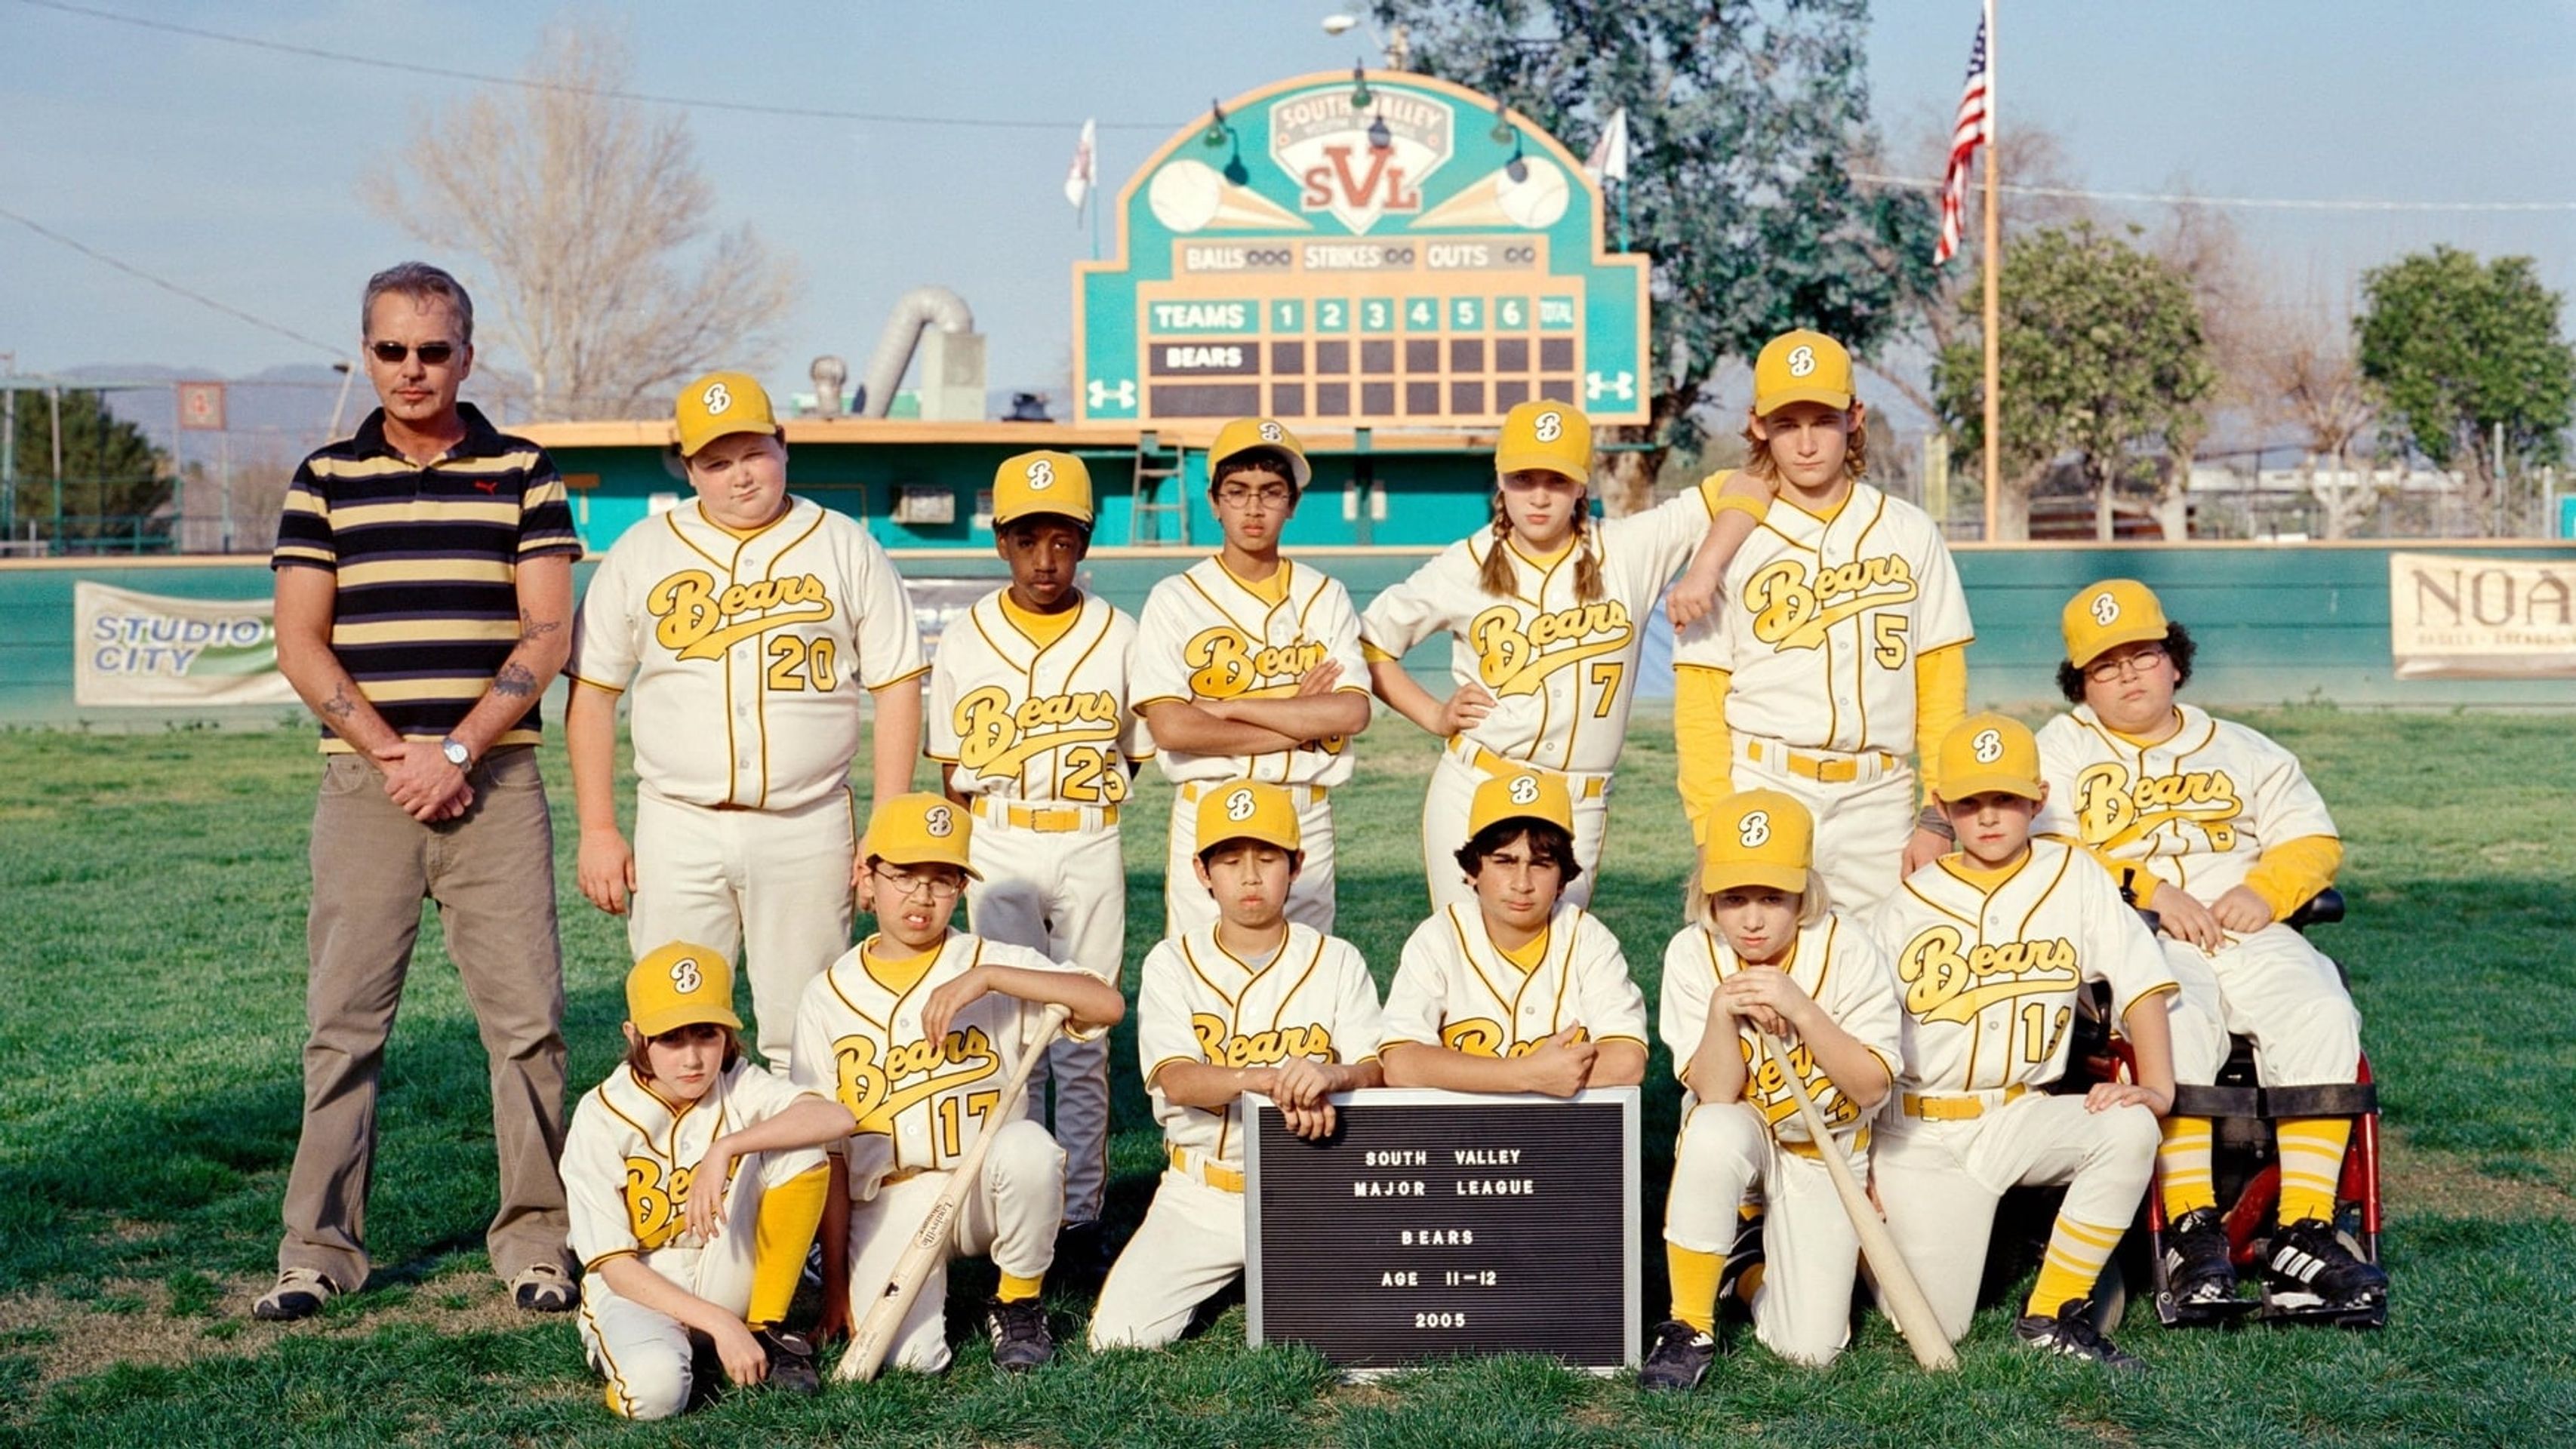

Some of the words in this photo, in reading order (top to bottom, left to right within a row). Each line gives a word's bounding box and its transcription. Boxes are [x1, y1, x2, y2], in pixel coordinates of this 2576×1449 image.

[1283, 97, 1353, 128] SOUTH
[1305, 146, 1417, 208] SVL
[1186, 248, 1245, 270] BALLS
[1305, 245, 1382, 269] STRIKES
[1428, 245, 1488, 267] OUTS
[1155, 304, 1245, 328] TEAMS
[1281, 304, 1292, 327] 1
[1323, 303, 1340, 327] 2
[1368, 303, 1384, 328] 3
[1411, 301, 1430, 325] 4
[1457, 301, 1474, 325] 5
[1503, 300, 1521, 325] 6
[1166, 346, 1242, 368] BEARS
[1787, 344, 1816, 377] B
[702, 382, 731, 416] B
[1257, 421, 1284, 441] B
[1534, 411, 1562, 443] B
[1026, 459, 1055, 491] B
[647, 569, 834, 661] Bears
[1743, 553, 1919, 654] Bears
[2091, 592, 2121, 627] B
[94, 616, 260, 643] STUDIO
[1874, 613, 1908, 671] 5
[94, 646, 194, 671] CITY
[768, 635, 838, 692] 20
[1470, 600, 1633, 699] Bears
[1591, 662, 1624, 718] 7
[954, 685, 1121, 780] Bears
[1972, 728, 2004, 763] B
[1060, 746, 1127, 803] 25
[1509, 774, 1540, 805] B
[925, 804, 953, 837] B
[1226, 787, 1256, 822] B
[2075, 761, 2243, 851] Bears
[1738, 810, 1771, 848] B
[670, 958, 703, 995] B
[1898, 924, 2081, 1025] Bears
[832, 1025, 1000, 1133] Bears
[938, 1088, 1001, 1158] 17
[1365, 1151, 1426, 1166] SOUTH
[1454, 1149, 1521, 1165] VALLEY
[1354, 1181, 1425, 1197] MAJOR
[1457, 1180, 1534, 1195] LEAGUE
[1402, 1230, 1473, 1245] BEARS
[1381, 1271, 1418, 1286] AGE
[1446, 1270, 1497, 1285] 11-12
[1415, 1313, 1465, 1327] 2005
